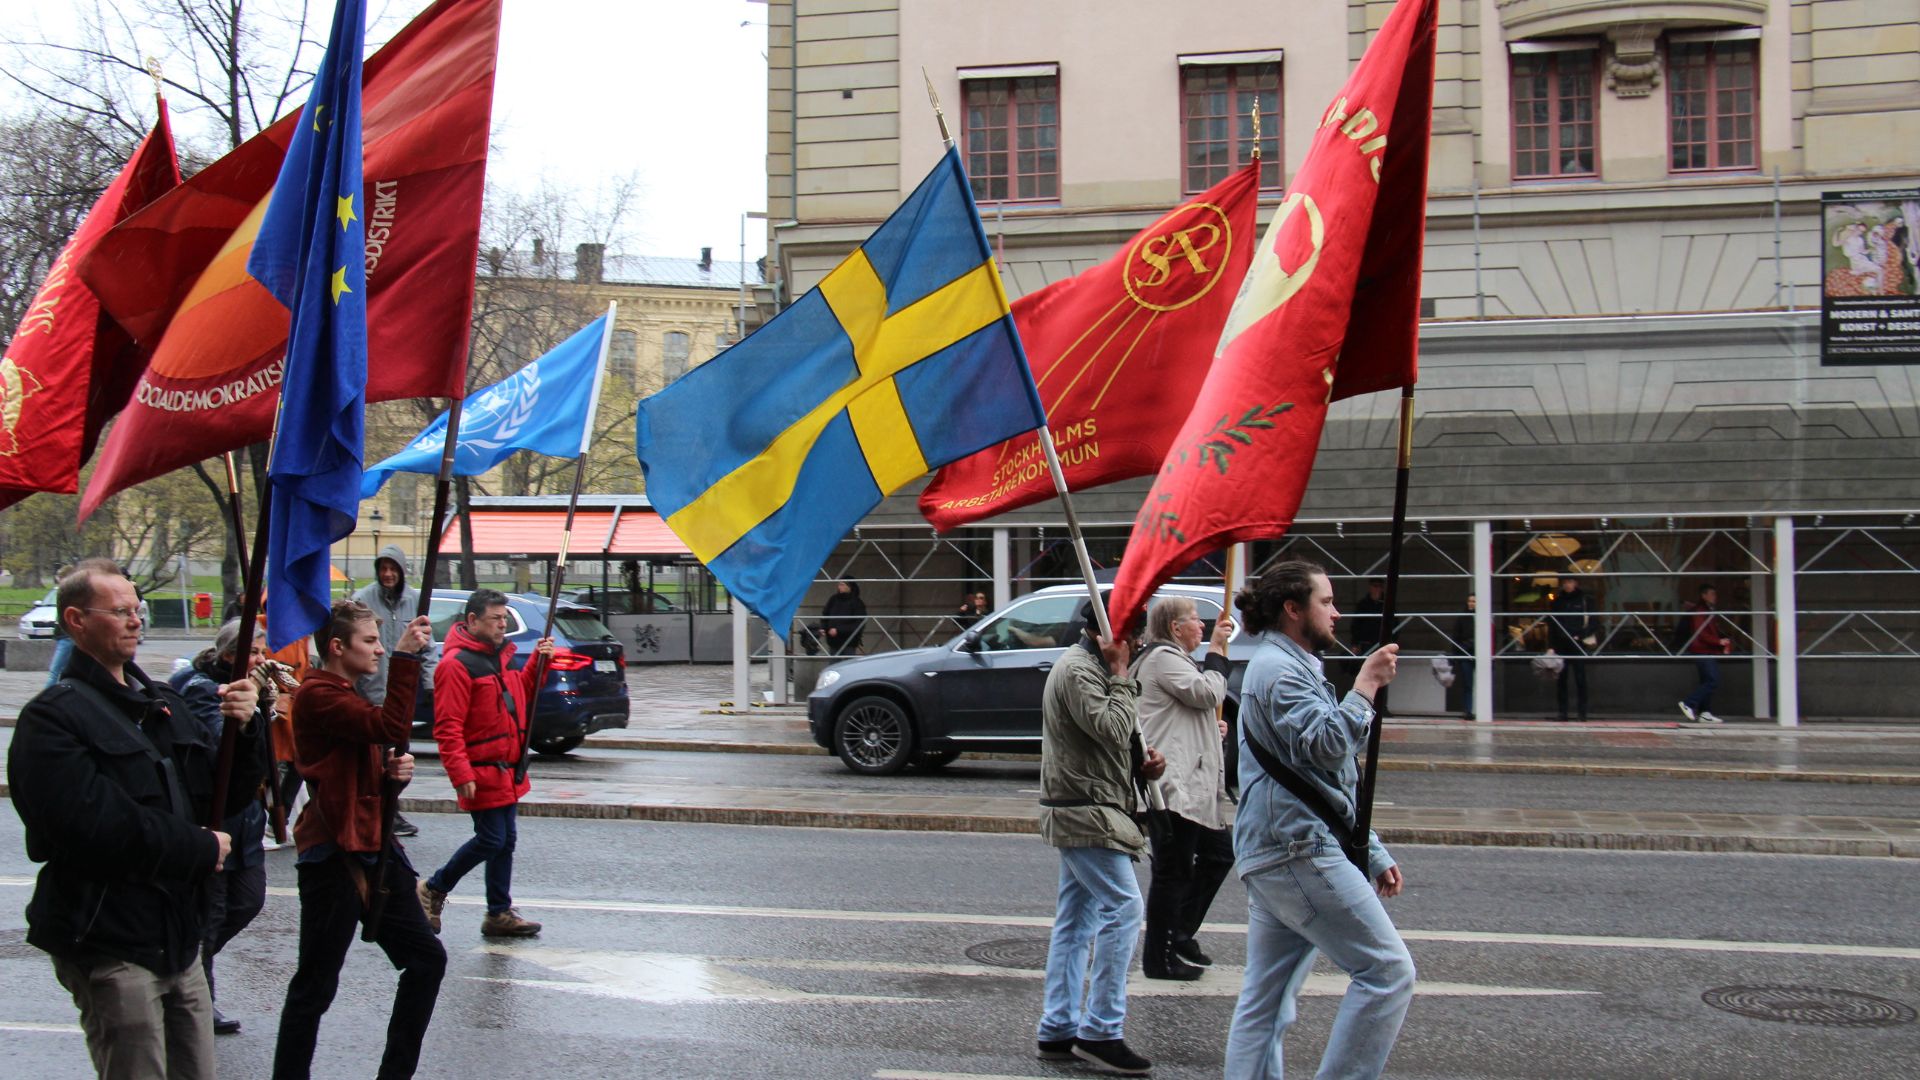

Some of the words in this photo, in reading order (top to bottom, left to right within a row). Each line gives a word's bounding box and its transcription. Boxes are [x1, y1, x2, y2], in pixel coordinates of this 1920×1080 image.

[1829, 310, 1878, 319] MODERN
[1879, 309, 1889, 318] &
[1839, 323, 1877, 332] KONST
[991, 418, 1097, 486] STOCKHLMS
